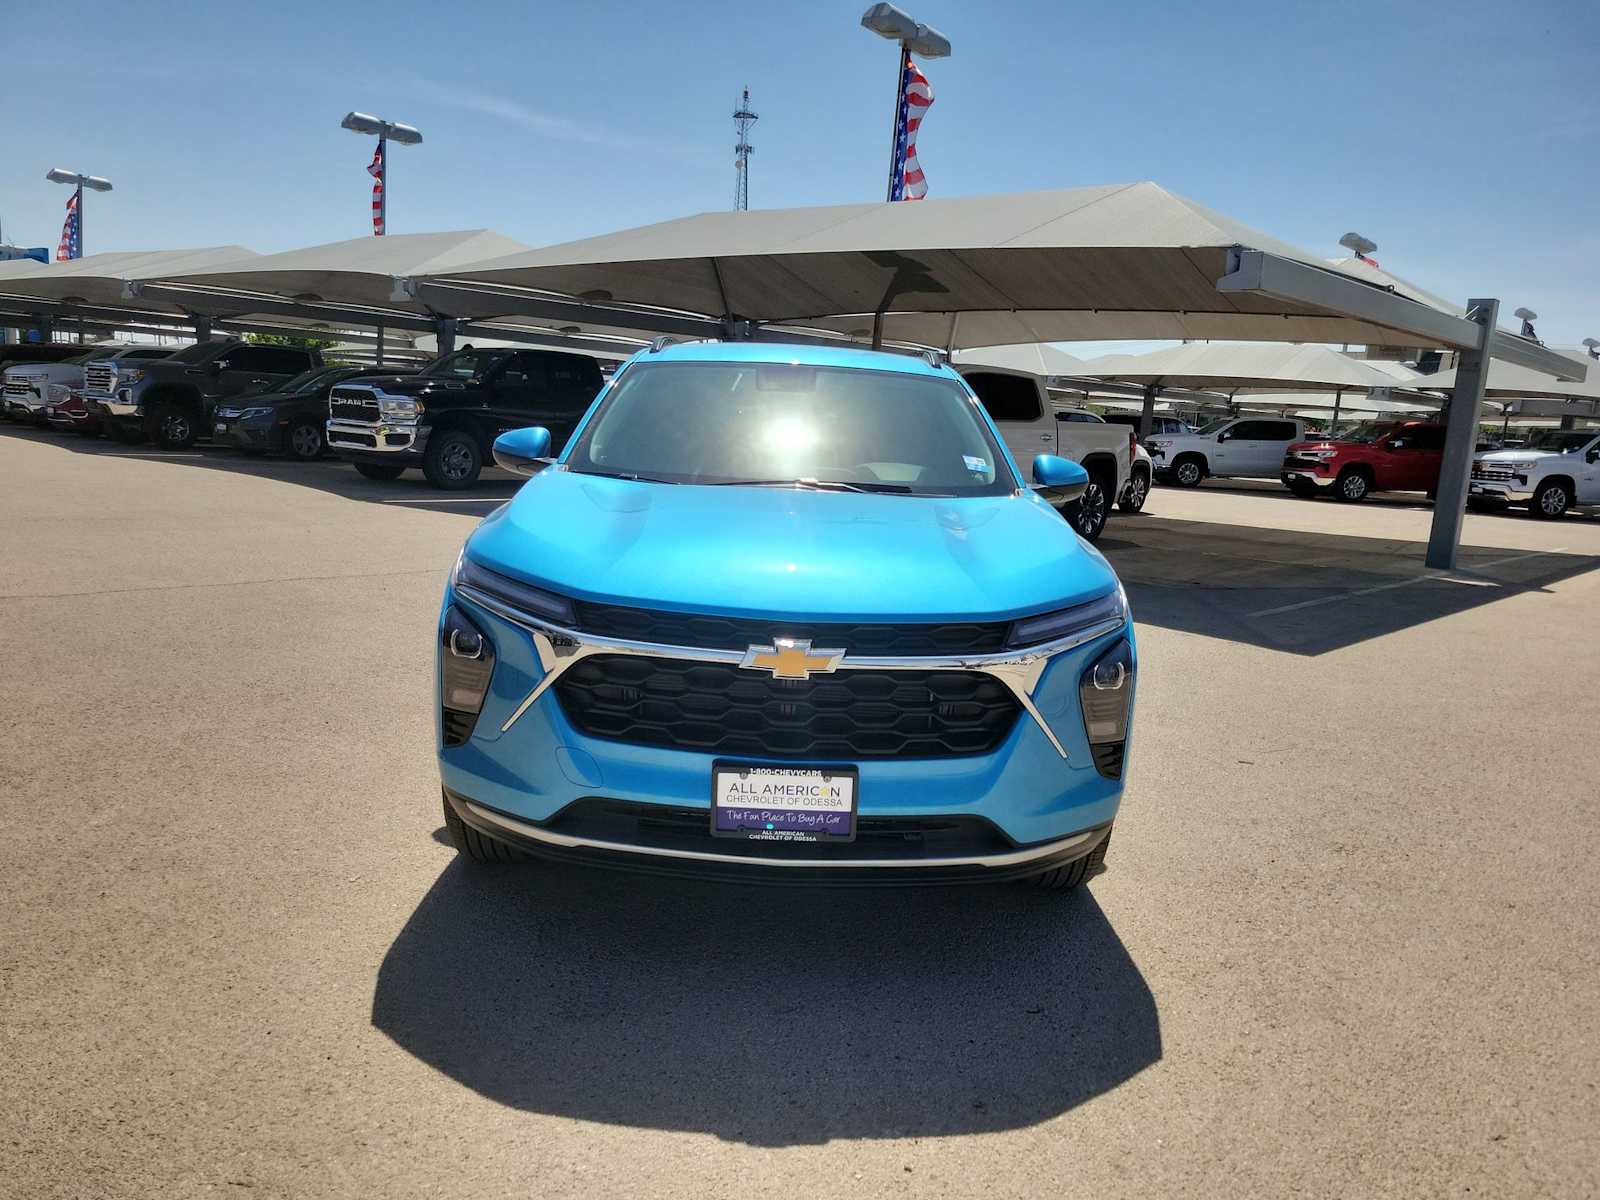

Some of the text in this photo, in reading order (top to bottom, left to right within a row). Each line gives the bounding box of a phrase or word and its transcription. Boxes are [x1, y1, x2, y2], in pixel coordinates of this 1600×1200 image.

[729, 783, 841, 797] ALL AMERICAN
[726, 795, 843, 807] CHEVROLET OF ODESSA
[727, 810, 741, 820] The
[761, 811, 785, 822] Place
[786, 812, 796, 823] To
[797, 814, 815, 826] Buy
[816, 814, 824, 824] A
[825, 814, 841, 824] Car
